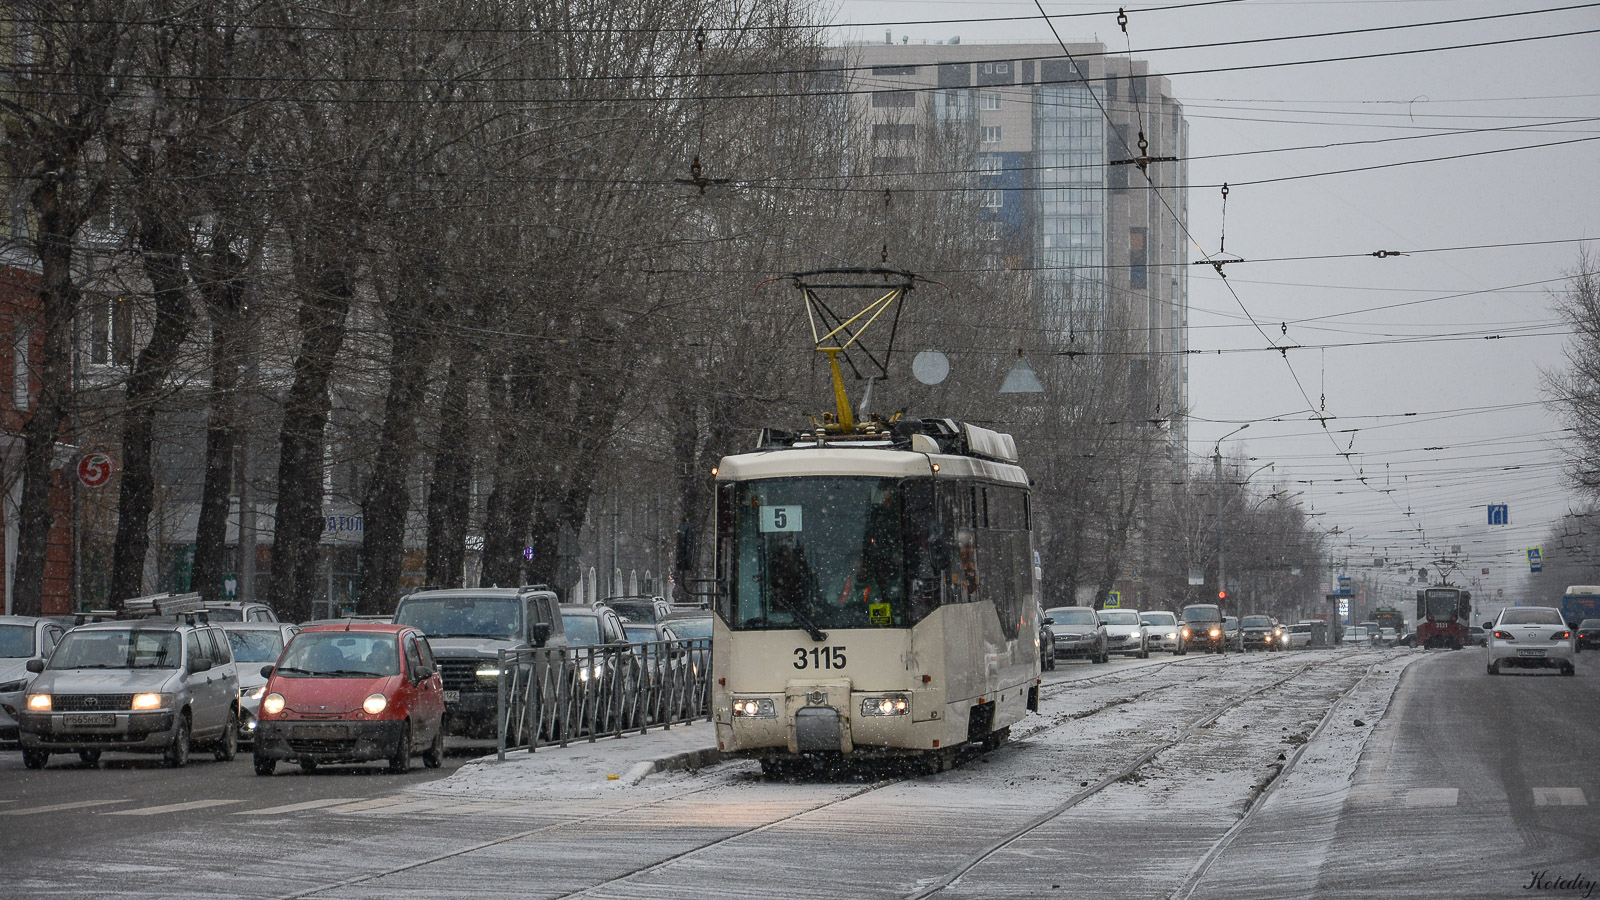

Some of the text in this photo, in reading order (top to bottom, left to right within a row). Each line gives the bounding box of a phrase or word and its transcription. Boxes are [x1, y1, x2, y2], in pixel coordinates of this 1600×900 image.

[86, 457, 105, 481] 5
[774, 508, 787, 529] 5
[793, 646, 847, 670] 3115
